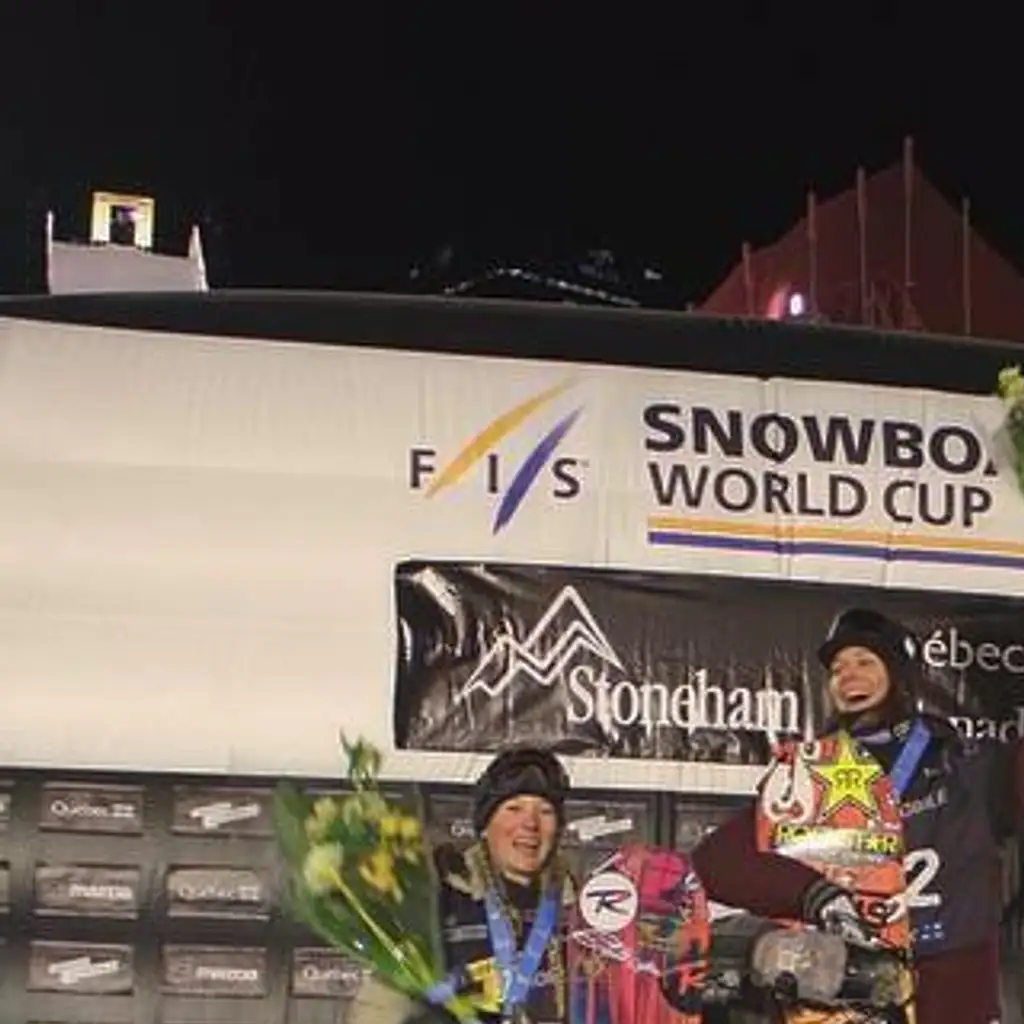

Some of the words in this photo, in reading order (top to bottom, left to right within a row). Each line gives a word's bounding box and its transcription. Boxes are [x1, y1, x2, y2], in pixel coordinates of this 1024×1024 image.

[648, 461, 868, 517] WORLD
[883, 480, 994, 527] CUP
[566, 664, 800, 733] Stoneham
